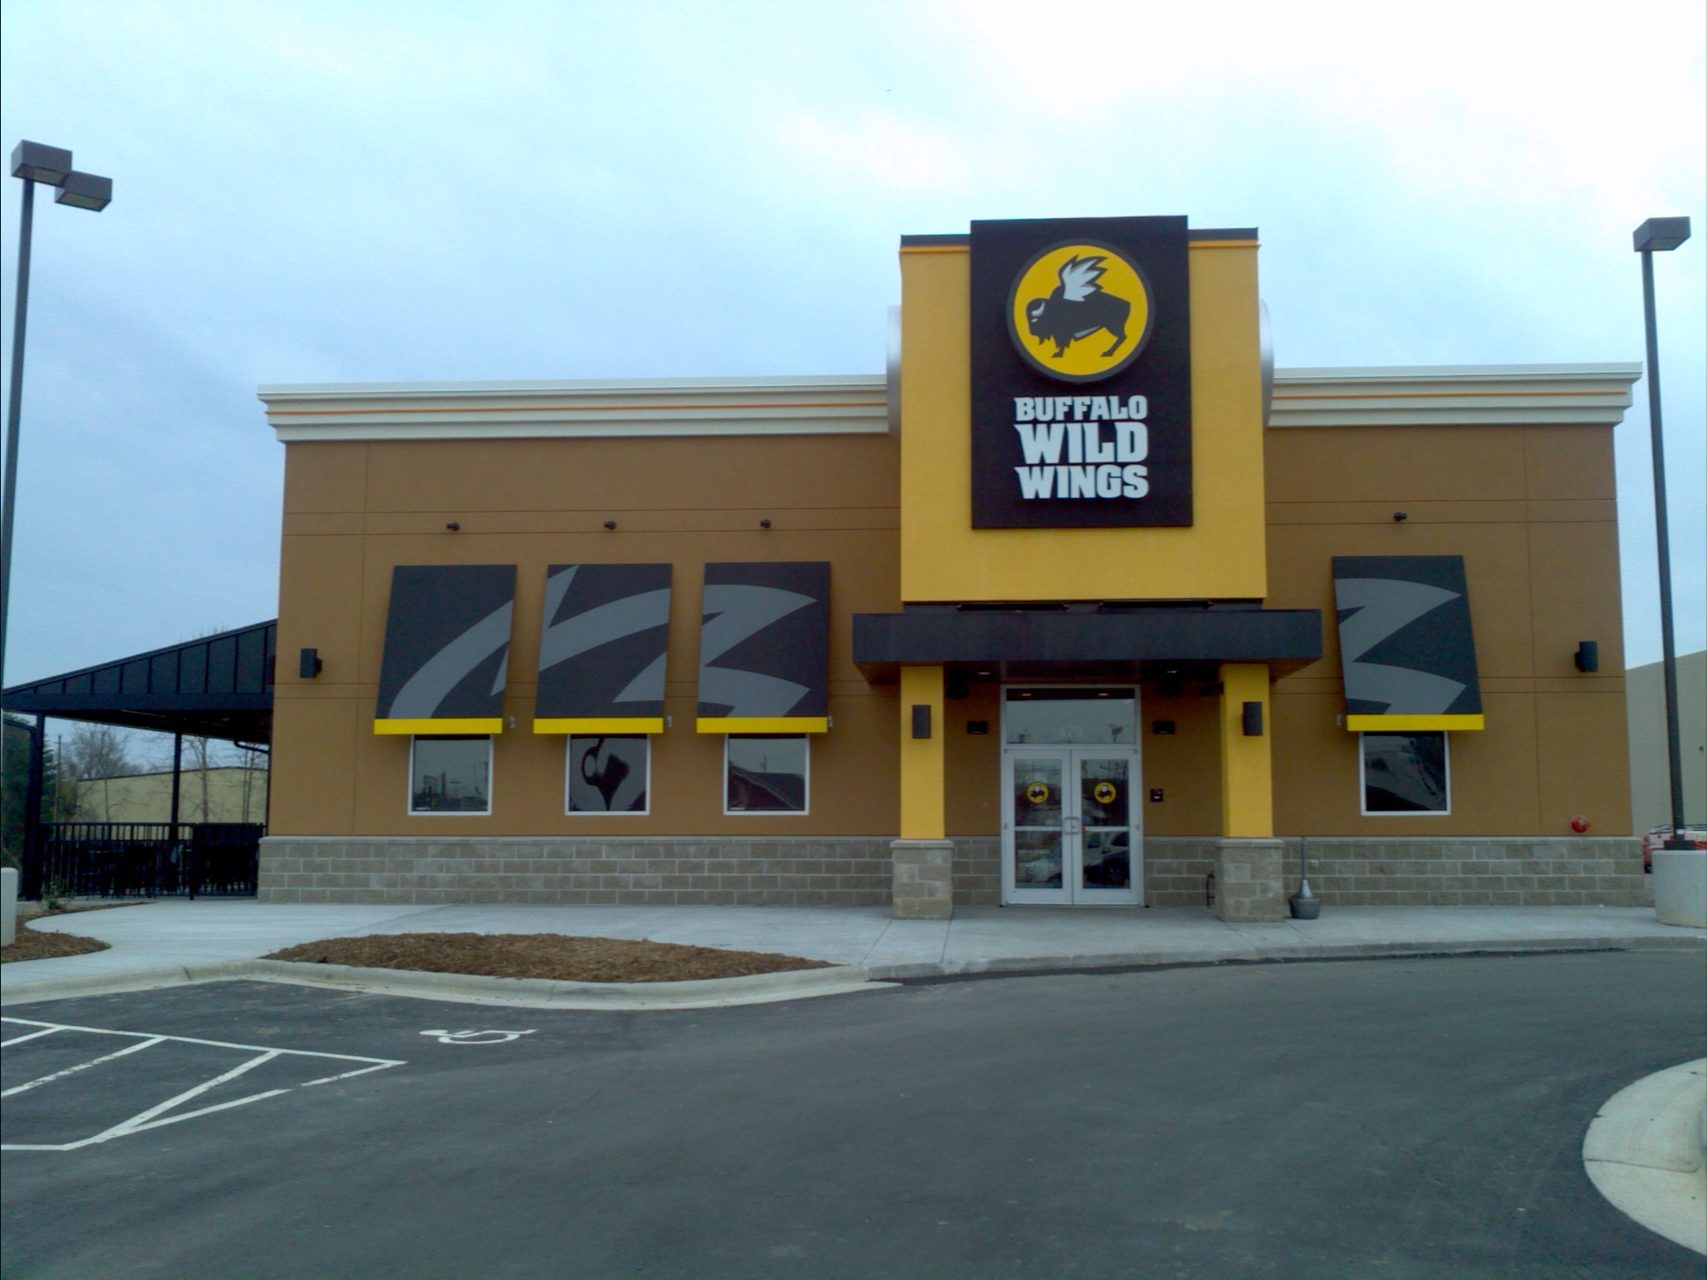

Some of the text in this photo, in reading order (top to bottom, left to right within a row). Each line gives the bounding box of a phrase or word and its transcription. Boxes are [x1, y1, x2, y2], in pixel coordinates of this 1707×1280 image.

[1014, 395, 1148, 422] BUFFALO
[1014, 421, 1149, 465] WILD
[1014, 464, 1150, 500] WINGS
